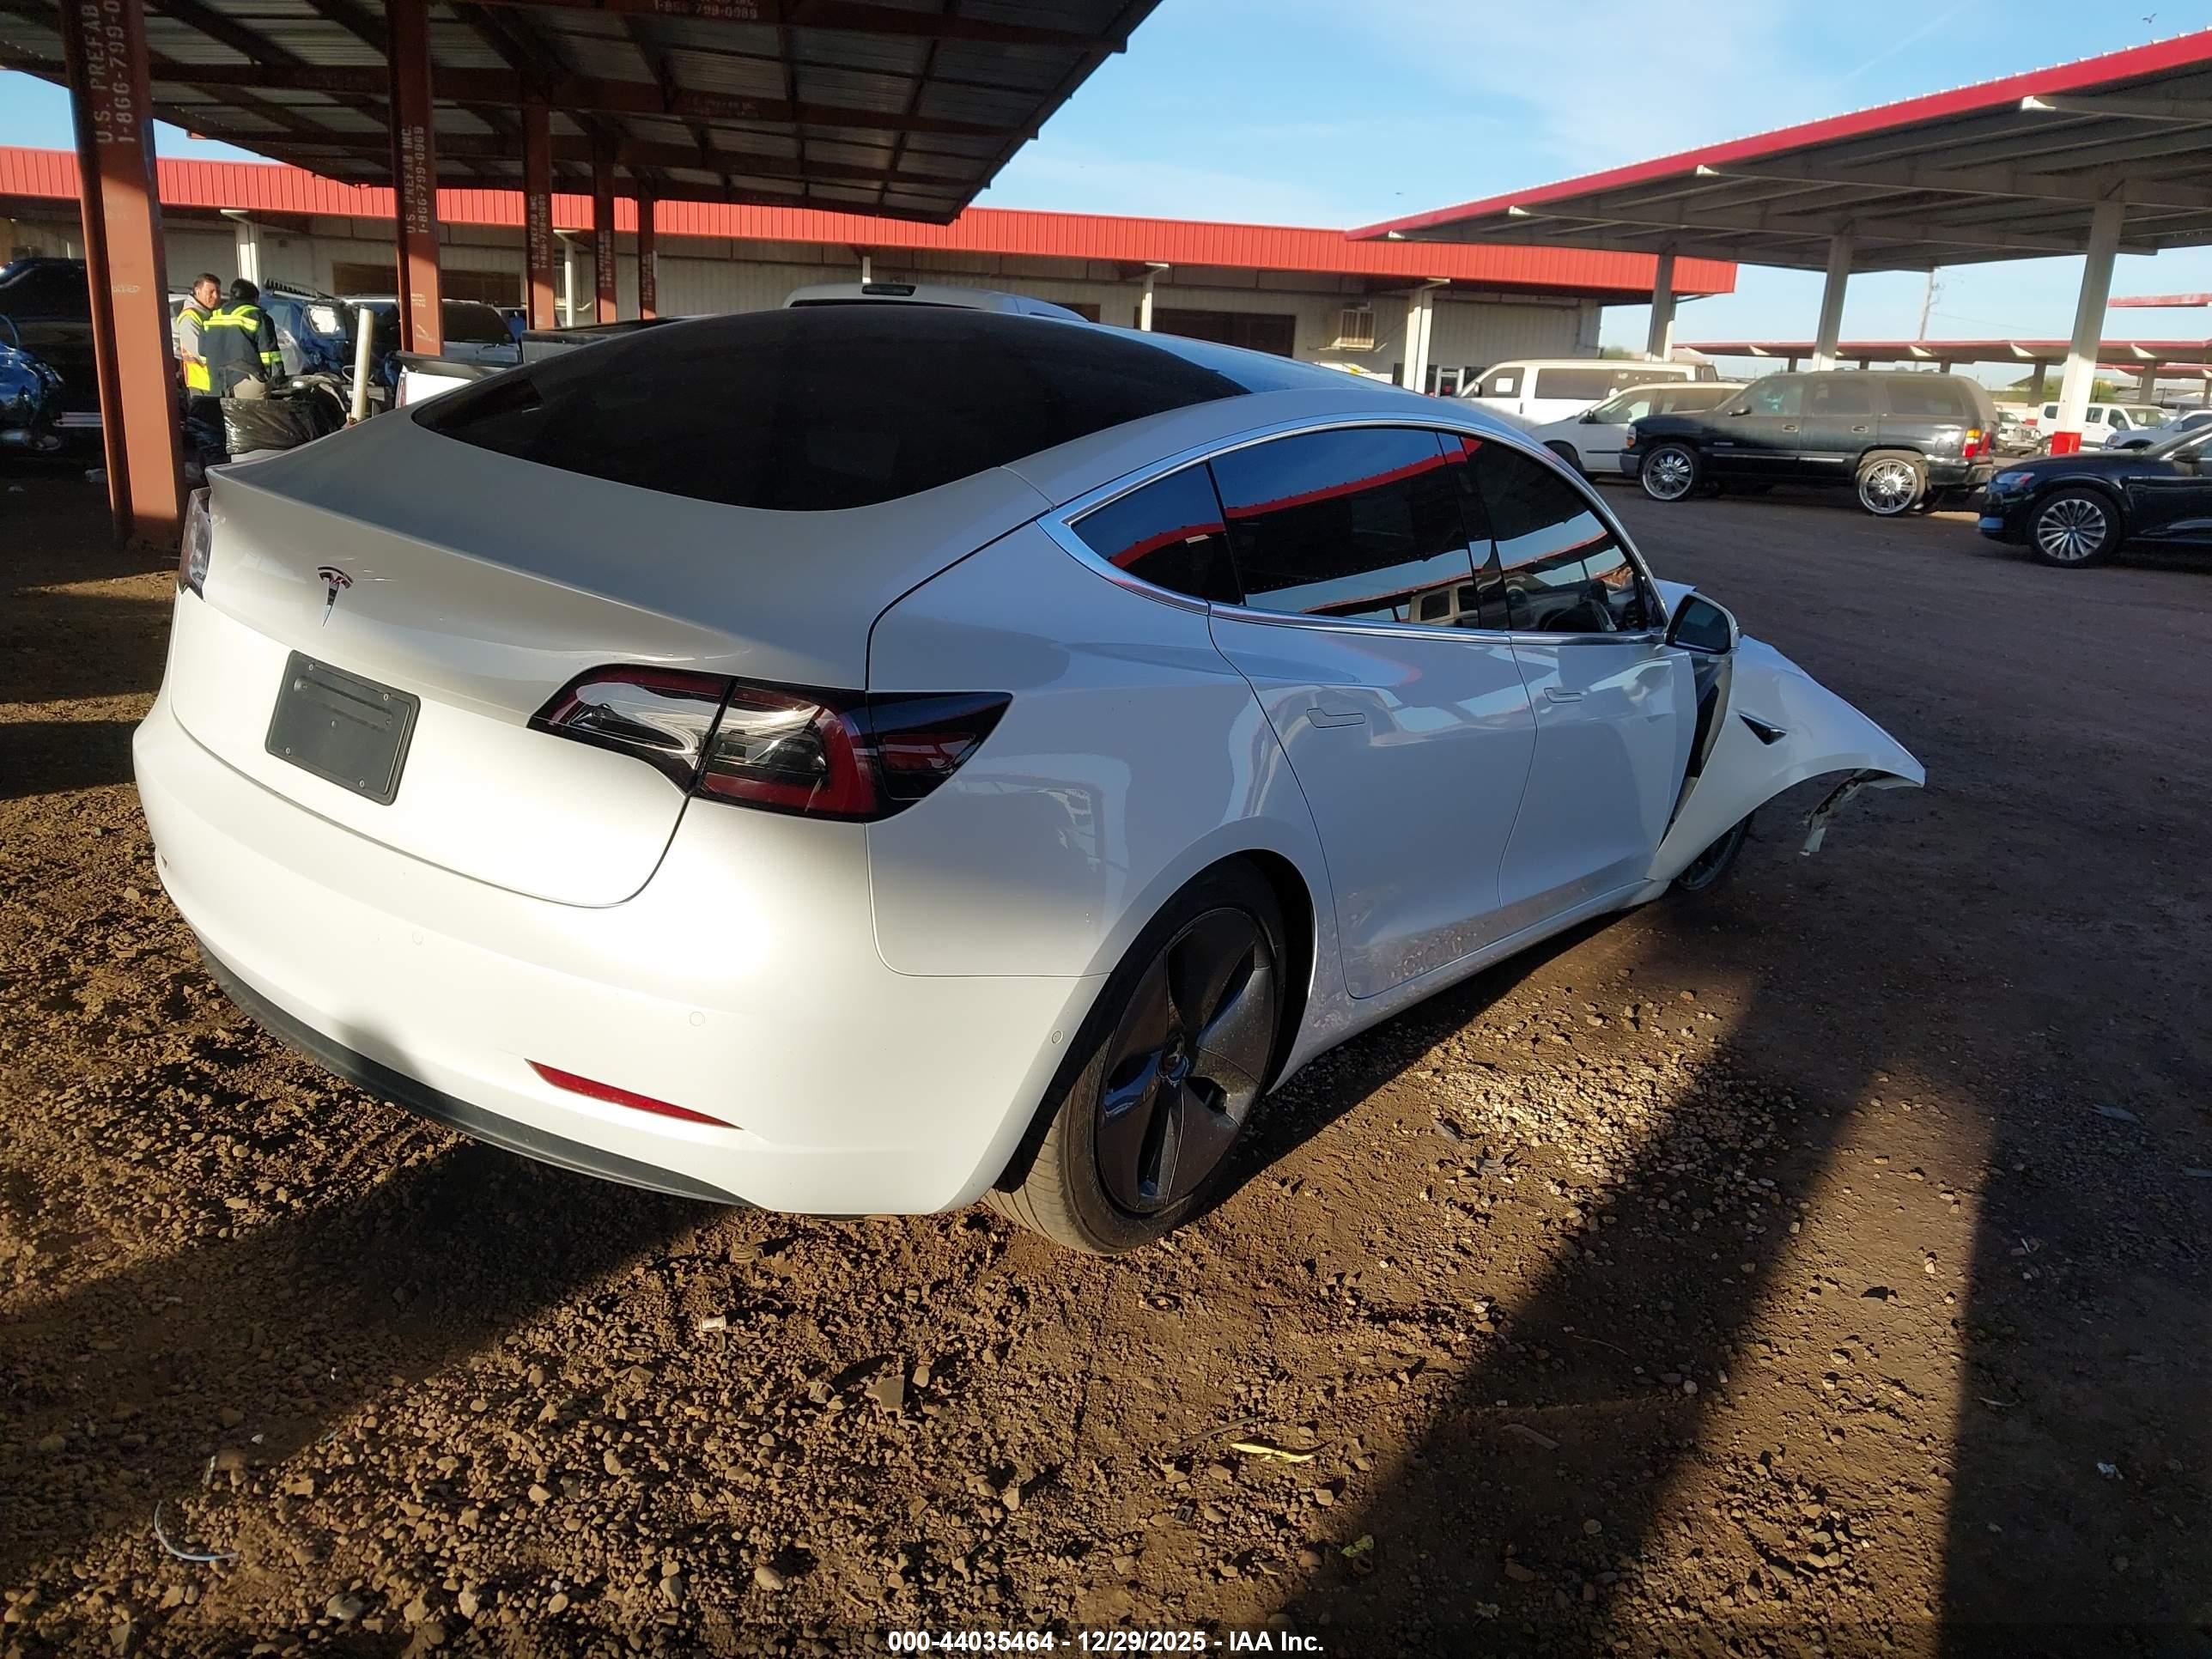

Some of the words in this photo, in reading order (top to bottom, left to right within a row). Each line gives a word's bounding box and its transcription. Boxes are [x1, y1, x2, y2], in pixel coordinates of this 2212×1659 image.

[82, 4, 108, 90] PREFAB
[94, 103, 113, 143] U.S.
[403, 155, 415, 204] PREFAB
[414, 126, 429, 234] 1-866-799-0969
